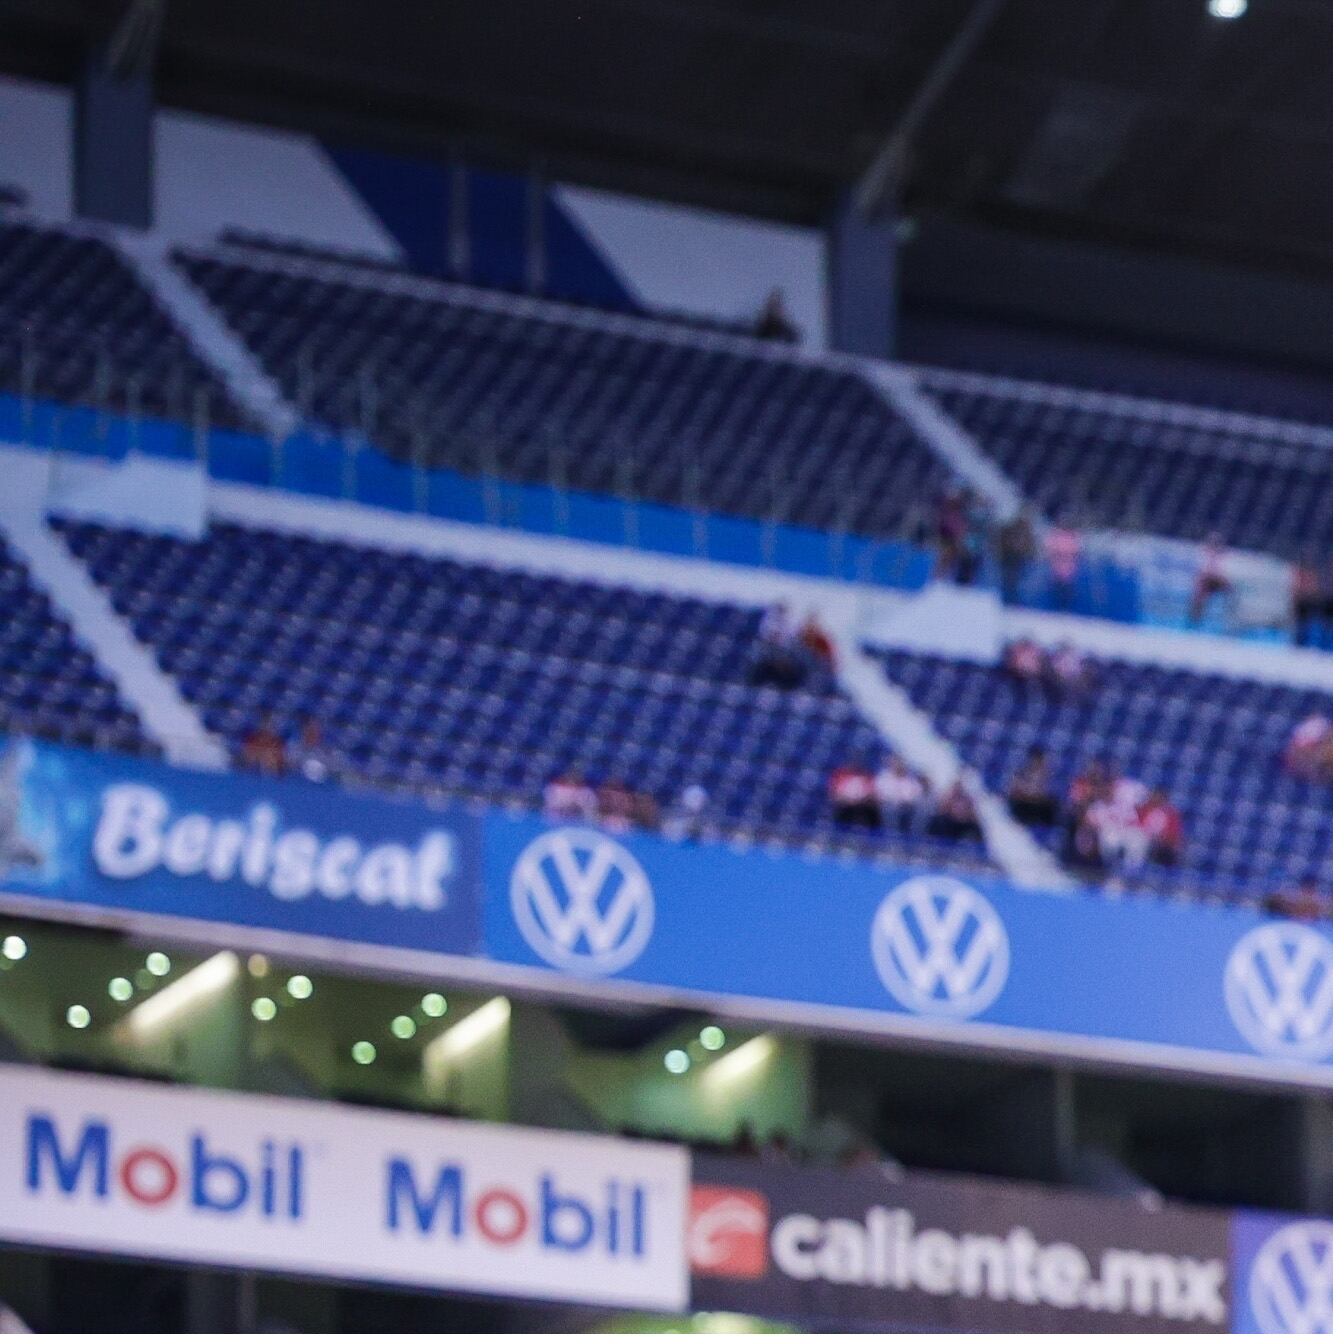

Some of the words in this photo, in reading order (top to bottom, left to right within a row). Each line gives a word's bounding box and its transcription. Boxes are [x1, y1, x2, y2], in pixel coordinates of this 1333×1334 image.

[517, 835, 648, 969] VW
[876, 882, 1004, 1014] VW
[26, 1112, 304, 1219] Mobil
[385, 1158, 648, 1258] Mobil
[772, 1207, 1226, 1322] caliente.mx
